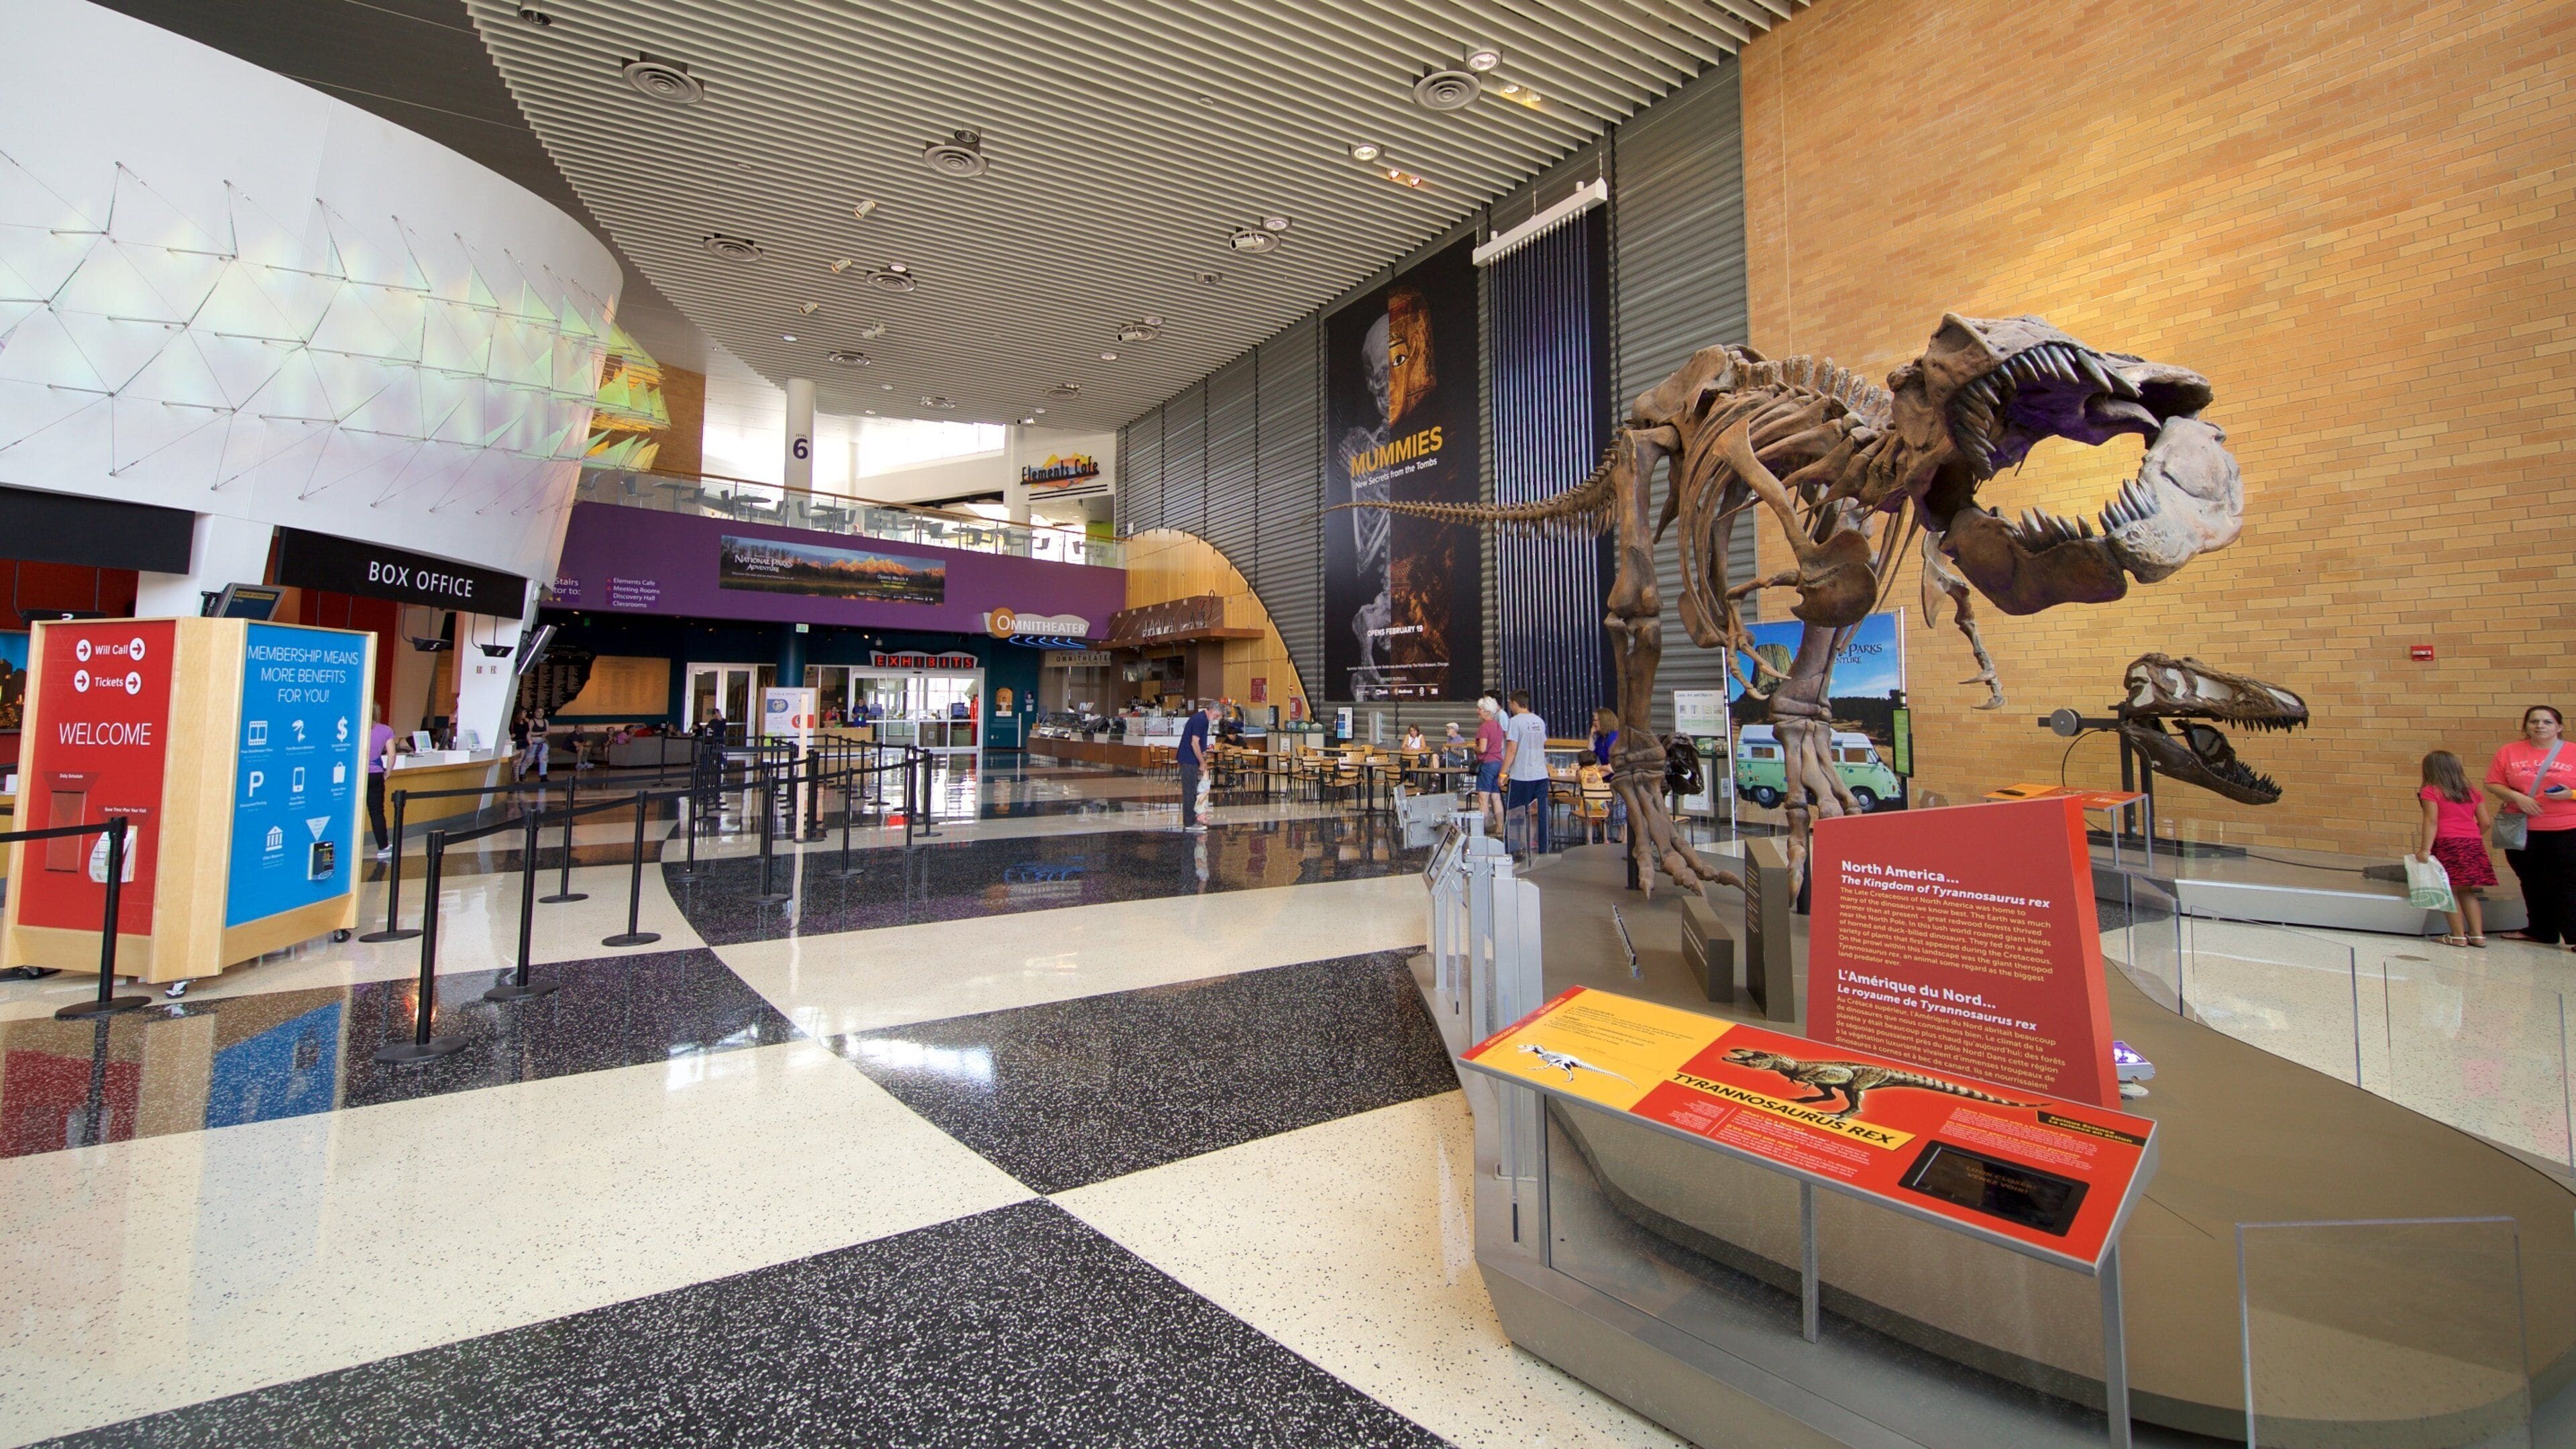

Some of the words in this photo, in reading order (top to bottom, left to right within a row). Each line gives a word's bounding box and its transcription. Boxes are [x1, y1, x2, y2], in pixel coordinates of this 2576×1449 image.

[793, 438, 808, 460] 6
[1350, 425, 1443, 478] MUMMIES
[1022, 460, 1069, 482] Elements
[1075, 455, 1098, 474] Cafe
[1355, 480, 1367, 489] New
[1368, 472, 1390, 486] Secrets
[1390, 468, 1404, 478] from
[1405, 464, 1415, 474] the
[1416, 458, 1438, 470] Tombs
[735, 555, 770, 566] NATIONAL
[771, 558, 794, 569] PARKS
[747, 564, 780, 573] ADVENTURE
[368, 561, 410, 588] BOX
[416, 571, 474, 598] OFFICE
[554, 578, 579, 586] Stairs
[613, 578, 641, 586] Elements
[569, 588, 581, 596] to:
[613, 586, 639, 594] Meeting
[613, 594, 643, 602] Discovery
[997, 614, 1085, 634] OMNITHEATER
[1142, 615, 1176, 638] JAVA
[1367, 628, 1385, 637] OPENS
[1386, 625, 1415, 636] FEBRUARY
[1416, 625, 1424, 633] 19
[95, 645, 110, 655] Will
[112, 644, 128, 655] Call
[248, 645, 321, 663] MEMBERSHIP
[324, 650, 359, 665] MEANS
[1849, 644, 1882, 657] PARKS
[877, 656, 972, 667] EXHIBITS
[95, 676, 123, 687] Tickets
[261, 667, 296, 682] MORE
[298, 669, 346, 684] BENEFITS
[278, 688, 301, 702] FOR
[304, 689, 329, 703] YOU!
[59, 722, 152, 745] WELCOME
[1841, 860, 1882, 875] North
[1885, 865, 1959, 883] America...
[1841, 875, 1860, 885] The
[1863, 877, 1914, 892] Kingdom
[1917, 884, 1930, 893] of
[1932, 885, 2025, 905] Tyrannosaurus
[2029, 899, 2049, 908] rex
[1840, 896, 1858, 904] many
[1880, 900, 1915, 910] dinosaurs
[1928, 906, 1949, 914] know
[1950, 909, 1968, 917] best.
[1986, 914, 2007, 922] Earth
[1870, 890, 1909, 901] Cretaceous
[1920, 896, 1941, 905] North
[1943, 900, 1974, 909] America
[1992, 906, 2015, 914] home
[1891, 911, 1918, 919] present
[1948, 919, 1982, 928] redwood
[1984, 922, 2011, 932] forests
[2012, 926, 2042, 936] thrived
[1919, 985, 1939, 998] du
[1943, 988, 1995, 1008] Nord...
[1837, 983, 1849, 994] Le
[1851, 989, 1900, 1004] royaume
[1902, 997, 1917, 1007] de
[1920, 1000, 2012, 1026] Tyrannosaurus
[2015, 1020, 2037, 1030] rex
[1673, 1073, 1847, 1130] TYRANNOSAURUS
[1847, 1126, 1896, 1144] REX
[1779, 1121, 1805, 1132] Name?
[2050, 1116, 2081, 1127] Serious
[2082, 1123, 2115, 1135] Science
[2059, 1122, 2091, 1133] science
[2104, 1132, 2133, 1143] action
[1777, 1140, 1799, 1149] nom?
[1966, 1166, 1993, 1177] LOOK
[1968, 1173, 1998, 1185] VENEZ
